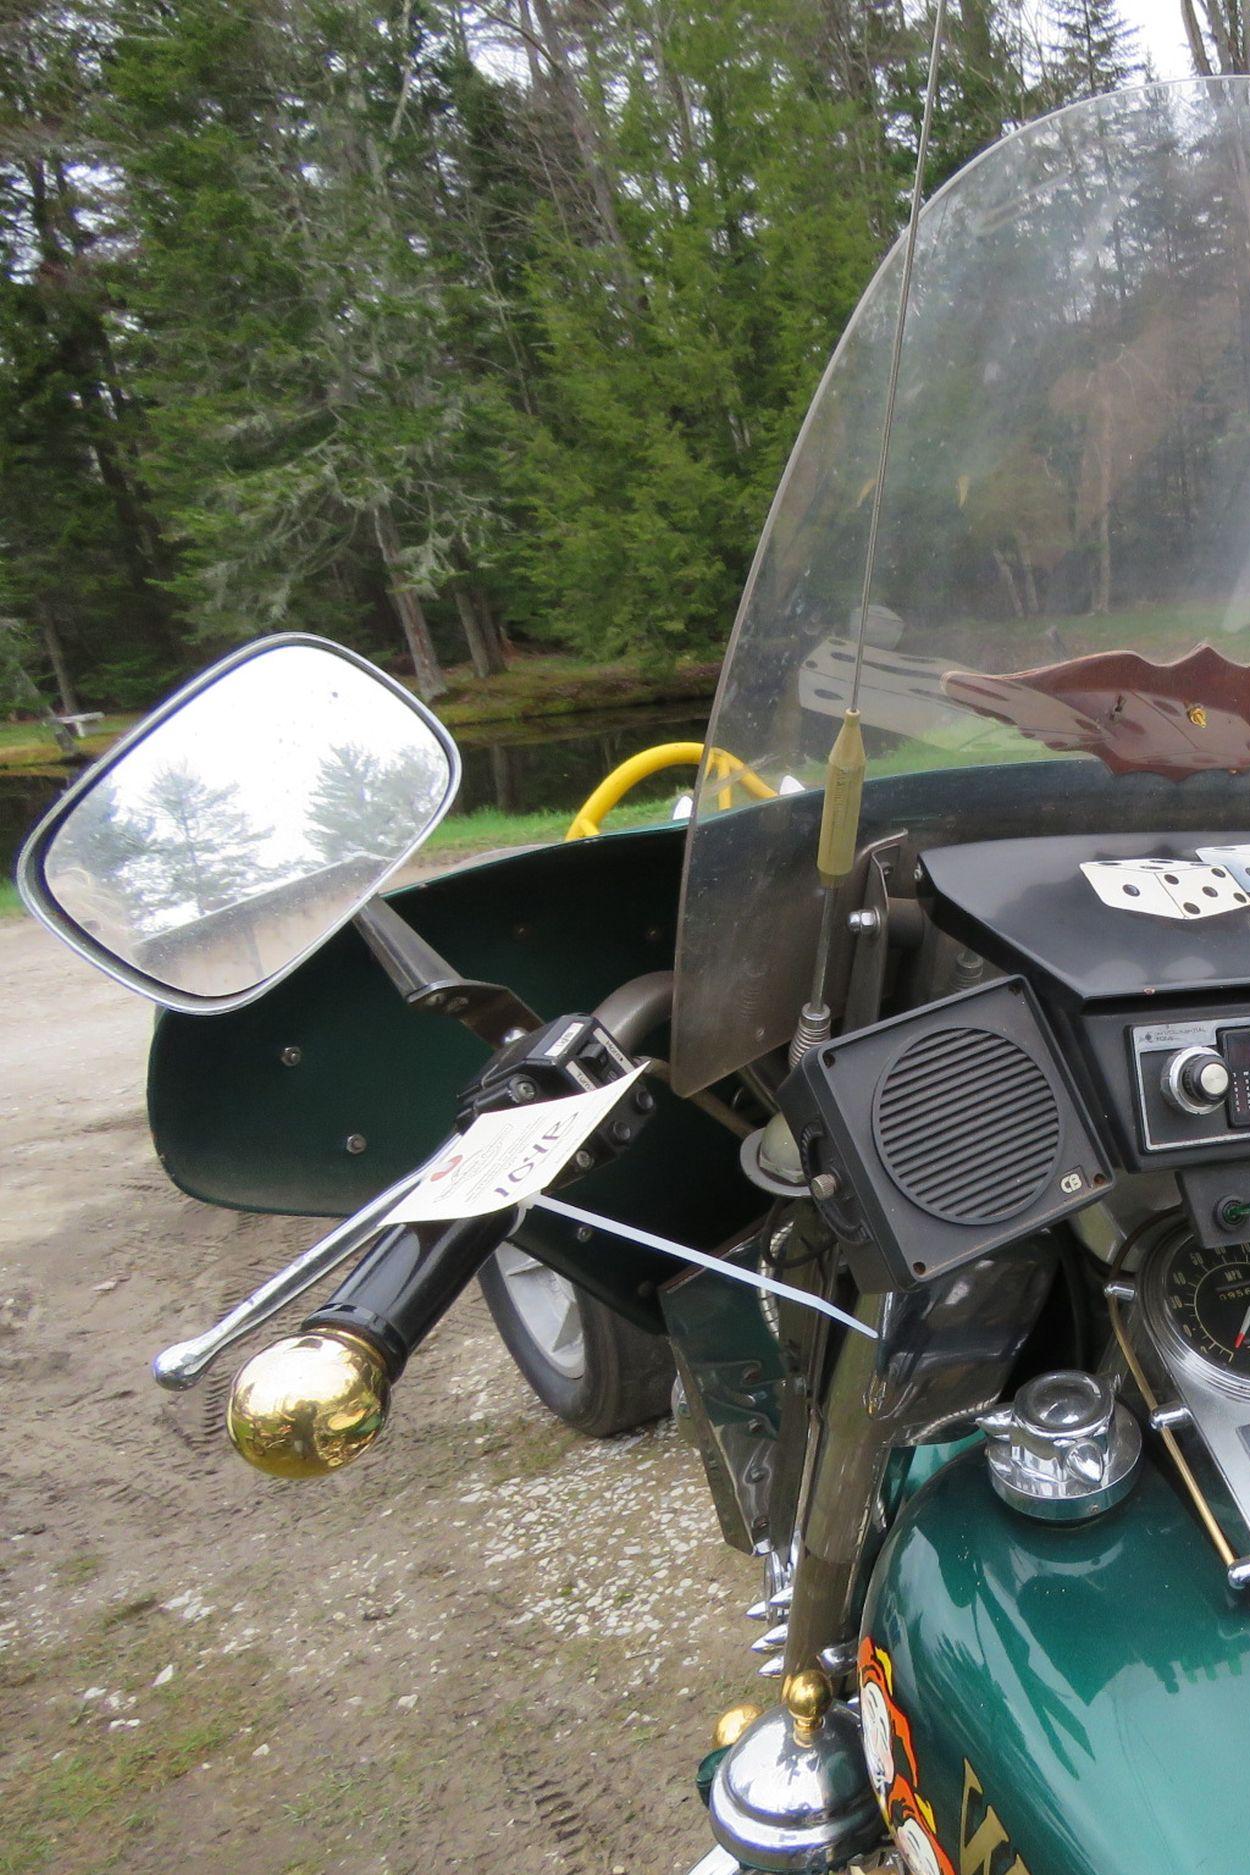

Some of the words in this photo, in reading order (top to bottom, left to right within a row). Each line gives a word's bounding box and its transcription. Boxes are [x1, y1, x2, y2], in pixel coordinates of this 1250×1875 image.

[605, 1040, 622, 1058] Horn
[577, 1072, 591, 1089] Turn
[1061, 1173, 1082, 1193] CB
[1189, 1252, 1204, 1267] 50
